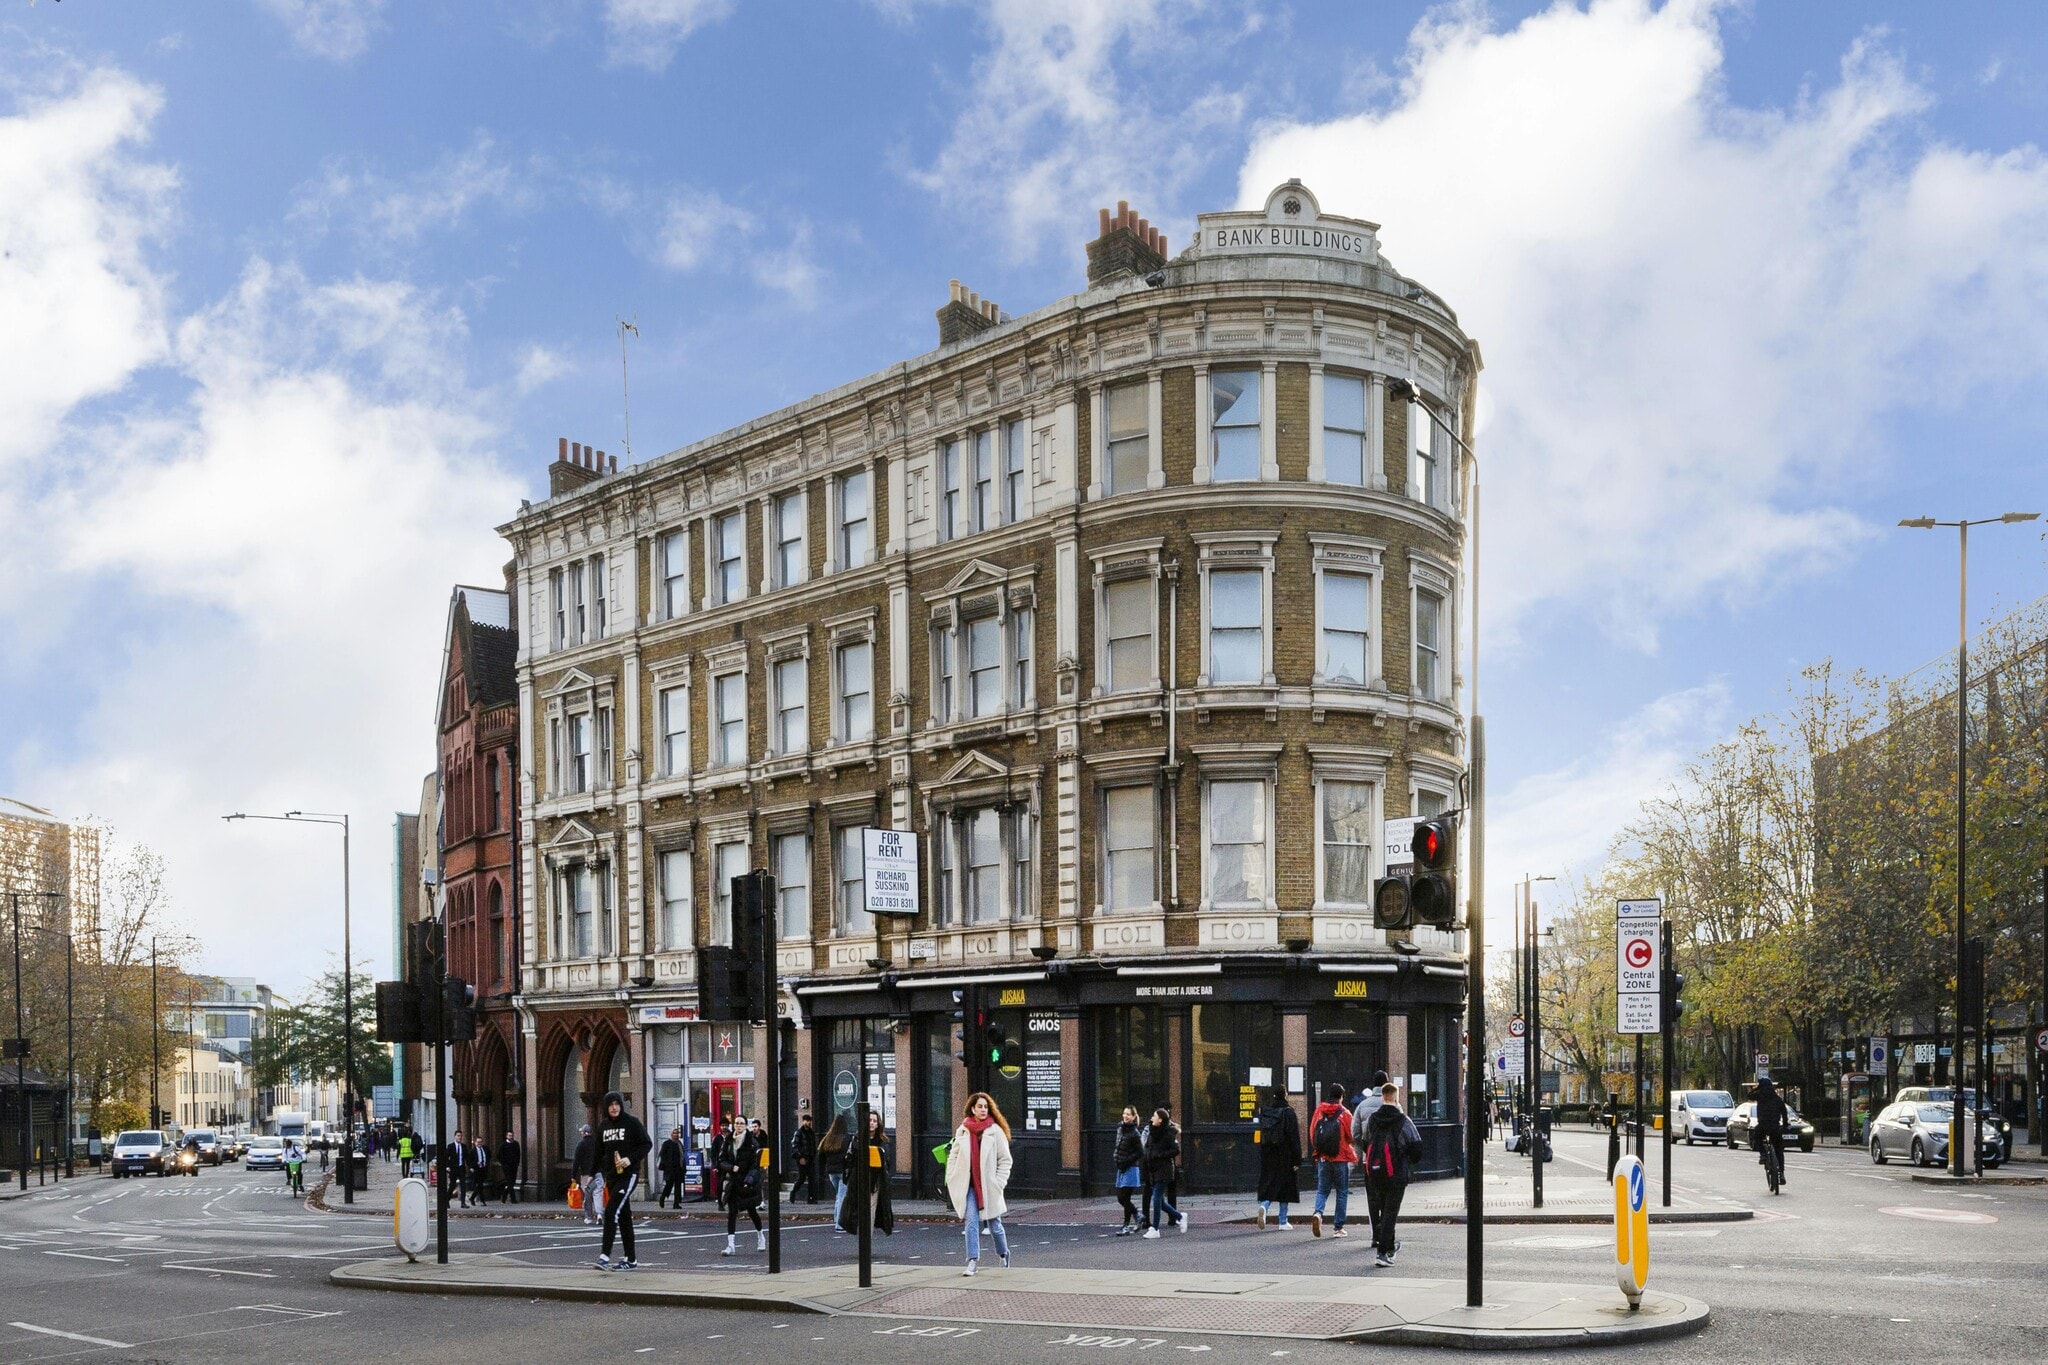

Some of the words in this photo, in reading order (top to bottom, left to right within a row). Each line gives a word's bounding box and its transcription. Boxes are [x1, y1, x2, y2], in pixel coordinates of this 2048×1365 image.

[1218, 228, 1263, 247] BANK
[1271, 228, 1362, 254] BUILDINGS
[881, 832, 900, 845] FOR
[878, 845, 903, 858] RENT
[1386, 844, 1401, 854] TO
[876, 871, 907, 882] RICHARD
[875, 881, 910, 892] SUSSKIND
[871, 896, 884, 907] 020
[885, 897, 899, 908] 7831
[900, 898, 914, 909] 8311
[1623, 971, 1655, 979] Central
[1334, 980, 1367, 996] JUSAKA
[1625, 980, 1652, 988] ZONE
[999, 989, 1026, 1004] JUSAKA
[1136, 986, 1151, 996] MORE
[1151, 986, 1166, 996] THAN
[1166, 986, 1180, 996] JUST
[1180, 986, 1185, 995] A
[1185, 986, 1201, 995] JUICE
[1201, 985, 1213, 995] BAR
[1028, 1019, 1060, 1032] GMOS
[1512, 1022, 1524, 1031] 20
